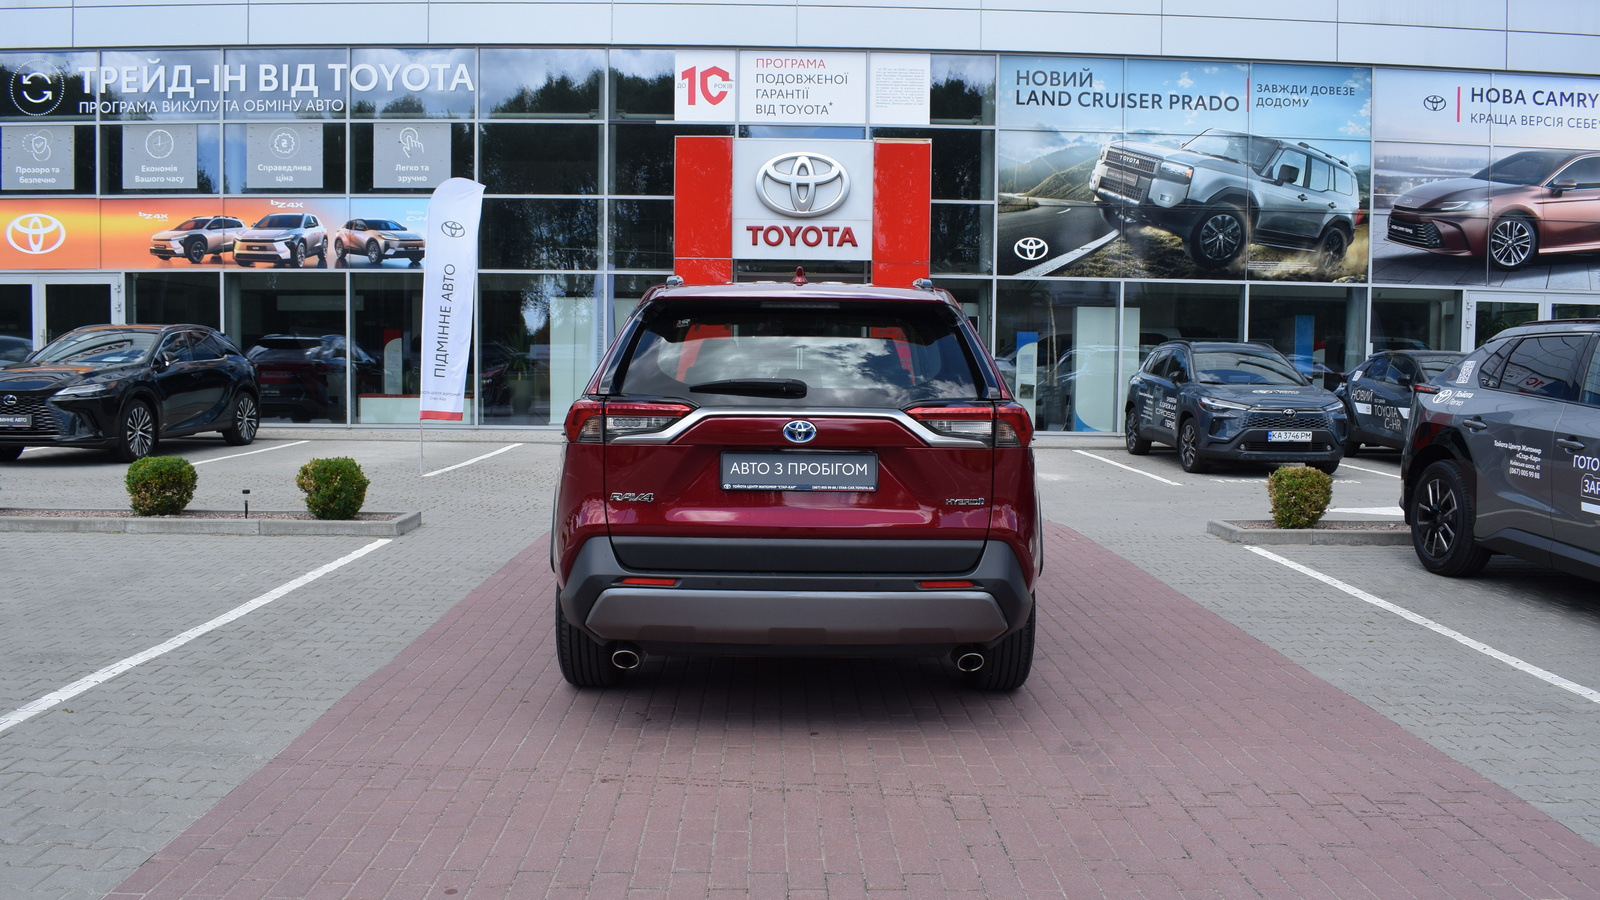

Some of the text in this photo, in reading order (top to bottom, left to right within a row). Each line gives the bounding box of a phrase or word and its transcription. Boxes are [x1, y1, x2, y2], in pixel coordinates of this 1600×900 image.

[756, 58, 826, 69] ПРОГРАМА
[78, 58, 475, 99] ТРЕЙД-ІН ВІД TOYOTA
[756, 72, 849, 86] ПОДОВЖЕНОЇ
[1016, 67, 1093, 88] НОВИЙ
[756, 86, 809, 99] ГАРАНТІЇ
[1256, 83, 1356, 96] ЗАВЖДИ ДОВЕЗЕ
[1015, 89, 1240, 112] LAND CRUISER PRADO
[1256, 97, 1310, 108] ДОДОМУ
[1471, 87, 1599, 109] НОВА CAMRY
[79, 99, 344, 114] ПРОГРАМА ВИКУПУ ТА ОБМІНУ АВТО
[756, 104, 776, 116] ВІД
[1470, 113, 1517, 127] КРАЩА
[1520, 115, 1563, 128] ВЕРСІЯ
[1119, 155, 1140, 165] TOYOTA
[15, 166, 50, 175] Прозоро
[257, 164, 312, 173] Справедлива
[19, 176, 56, 184] безпечно
[135, 175, 185, 184] Вашого часу
[275, 174, 294, 183] ціна
[397, 175, 427, 183] зручно
[746, 225, 858, 247] TOYOTA
[433, 263, 456, 378] ПІДМІННЕ АВТО
[1351, 389, 1373, 402] НОВИЙ
[1155, 408, 1176, 420] CROSS
[1374, 405, 1399, 418] TOYOTA
[1384, 418, 1402, 430] C-HR
[1283, 432, 1299, 440] 3746
[729, 462, 868, 476] АВТО З ПРОБІГОМ
[610, 492, 654, 502] RAV4
